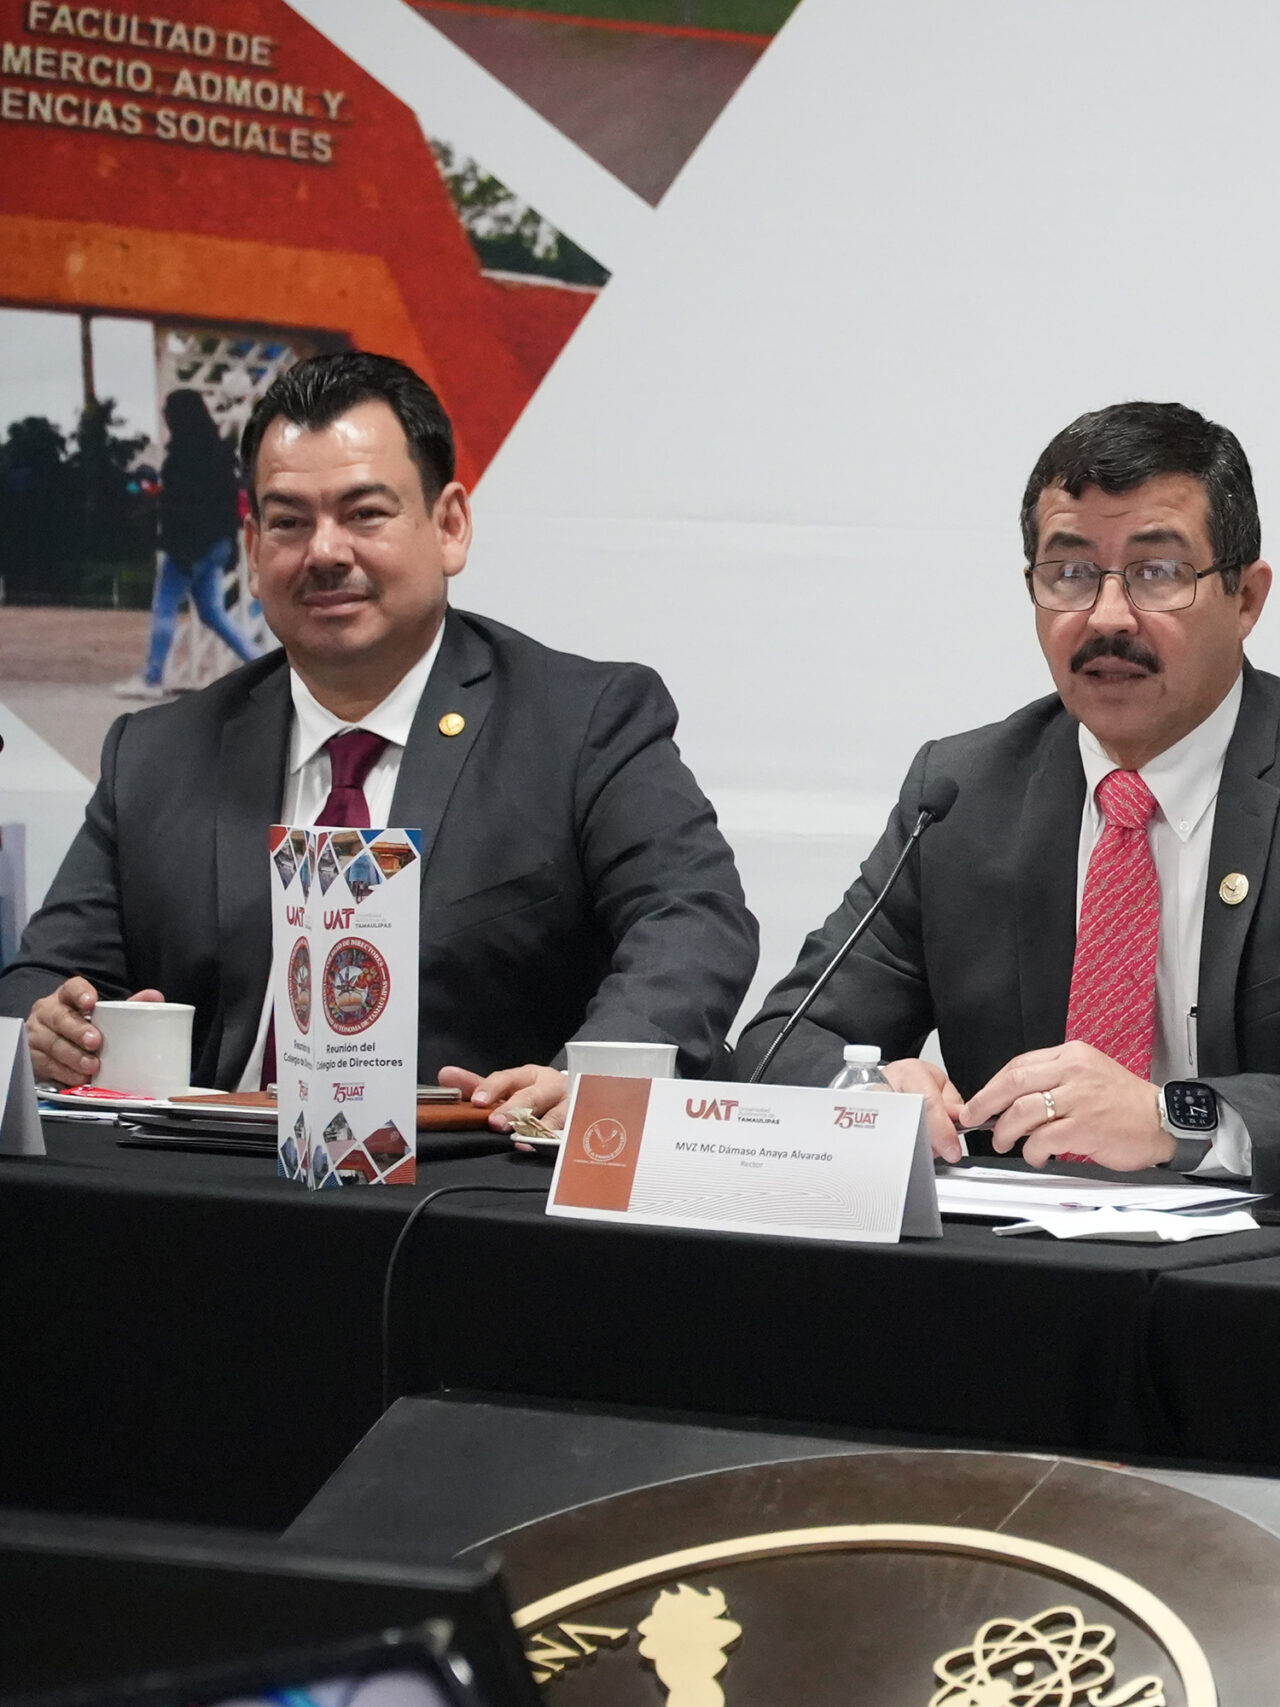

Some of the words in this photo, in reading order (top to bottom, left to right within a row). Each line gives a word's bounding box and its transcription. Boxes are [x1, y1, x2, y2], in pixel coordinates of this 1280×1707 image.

[27, 0, 217, 57] FACULTAD
[226, 31, 273, 67] DE
[322, 89, 345, 120] Y
[0, 87, 143, 135] ENCIAS
[155, 108, 334, 164] SOCIALES
[286, 904, 305, 928] UAT
[323, 908, 355, 930] UAT
[326, 1042, 358, 1054] Reunión
[359, 1042, 376, 1052] del
[337, 1058, 347, 1068] de
[349, 1057, 403, 1068] Directores
[685, 1098, 739, 1121] UAT
[675, 1141, 697, 1152] MVZ
[700, 1143, 716, 1153] MC
[718, 1143, 757, 1157] Dámaso
[759, 1147, 788, 1160] Anaya
[790, 1149, 833, 1162] Alvarado
